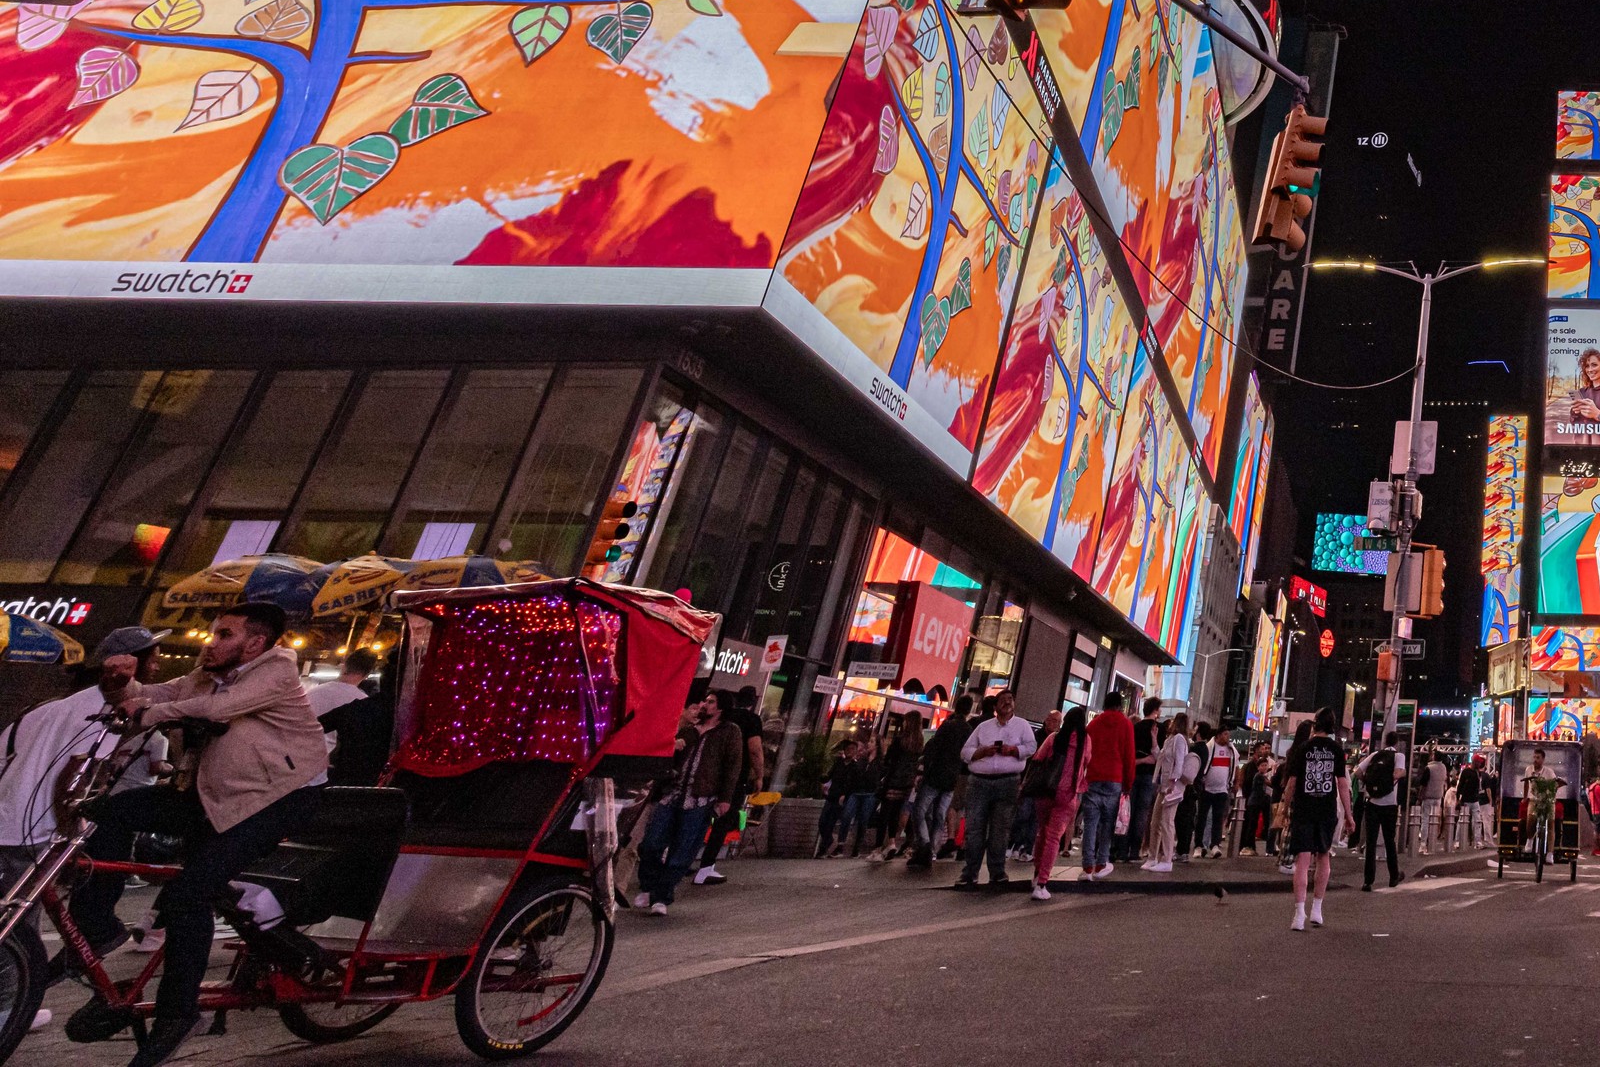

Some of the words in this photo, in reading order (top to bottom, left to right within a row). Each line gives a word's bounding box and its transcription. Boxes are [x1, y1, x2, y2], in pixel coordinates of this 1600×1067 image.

[111, 269, 230, 293] swatch
[1550, 347, 1579, 356] coming
[870, 377, 902, 417] swatch
[1365, 539, 1373, 549] W
[1376, 539, 1387, 549] 45
[912, 613, 962, 663] Levi's
[1402, 645, 1418, 653] WAY
